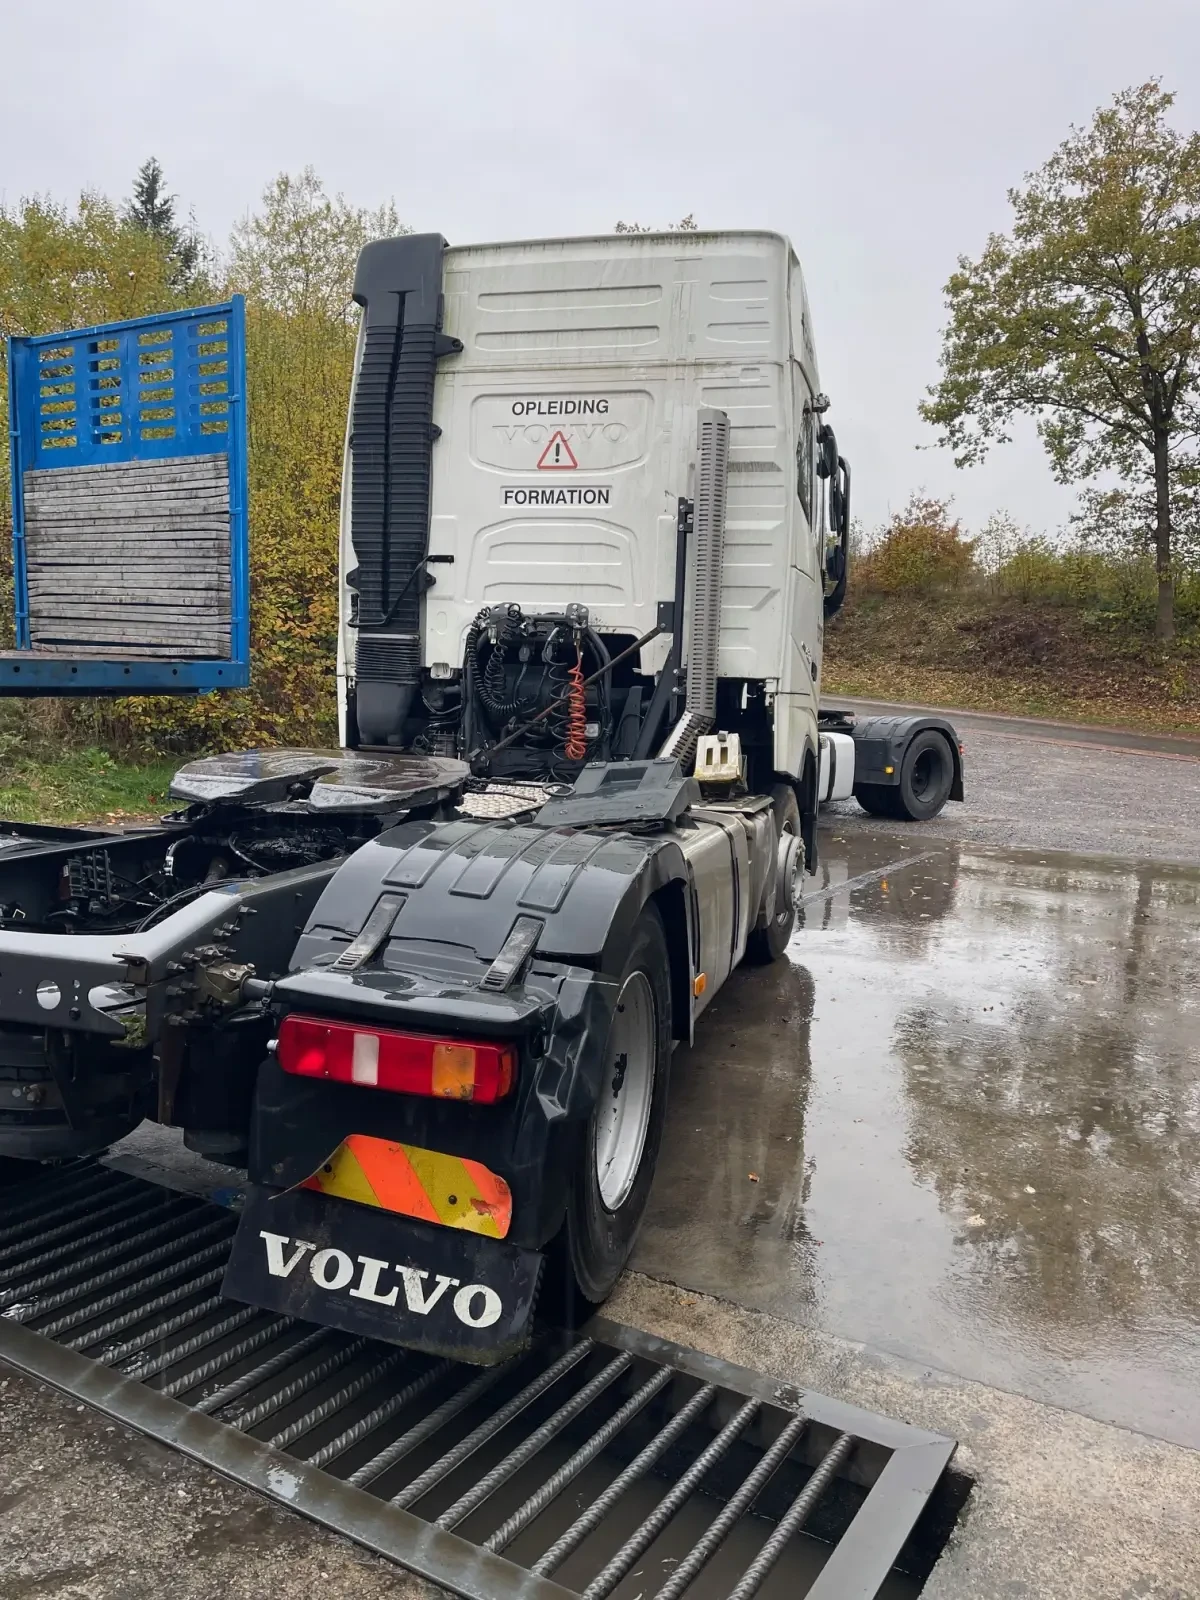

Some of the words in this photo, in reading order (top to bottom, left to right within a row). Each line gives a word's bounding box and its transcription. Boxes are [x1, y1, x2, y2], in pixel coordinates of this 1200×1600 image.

[511, 399, 609, 415] OPLEIDING
[504, 489, 610, 504] FORMATION
[259, 1231, 502, 1328] VOLVO
